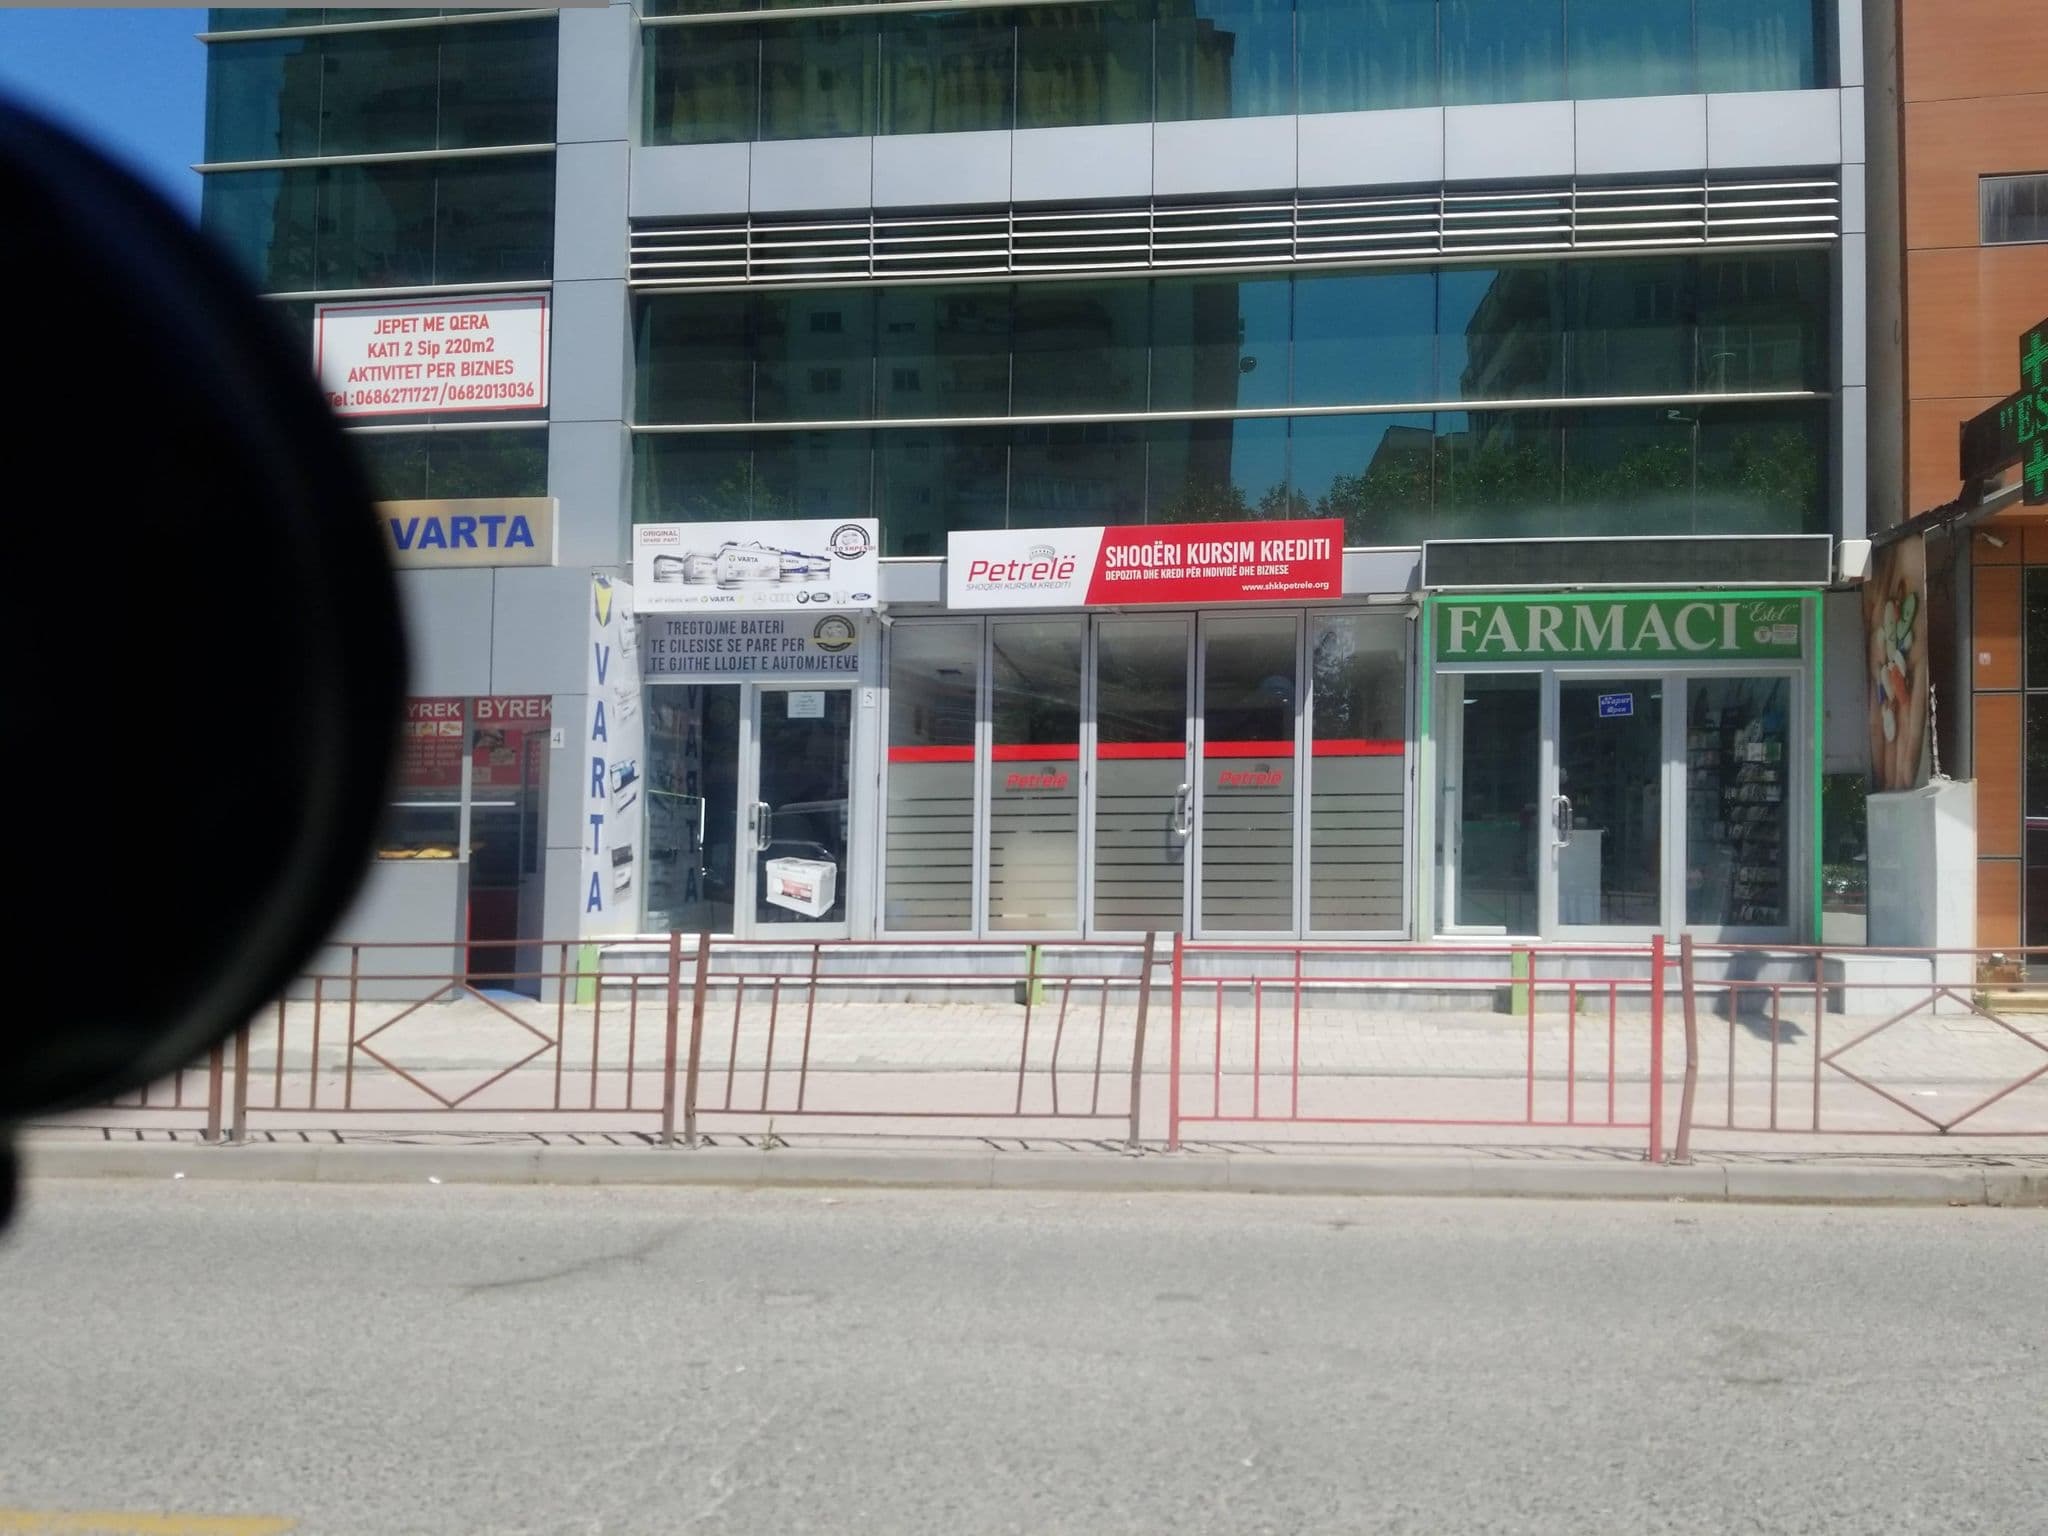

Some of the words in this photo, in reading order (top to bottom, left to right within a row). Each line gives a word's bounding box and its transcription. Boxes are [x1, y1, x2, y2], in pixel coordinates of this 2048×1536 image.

[374, 318, 419, 334] JEPET
[423, 316, 445, 332] ME
[449, 314, 489, 331] QERA
[368, 341, 400, 358] KATI
[404, 341, 413, 356] 2
[417, 340, 440, 359] Sip
[445, 337, 495, 354] 220m2
[348, 364, 423, 382] AKTIVITET
[427, 362, 455, 378] PER
[461, 359, 514, 376] BIZNES
[390, 515, 534, 549] VARTA
[1106, 540, 1181, 568] SHOQËRI
[1187, 541, 1254, 565] KURSIM
[1261, 538, 1330, 562] KREDITI
[968, 555, 1076, 582] Petrelë
[1106, 569, 1142, 581] DEPOZITA
[1143, 569, 1160, 580] DHE
[1161, 568, 1184, 579] KREDI
[1186, 566, 1201, 578] PËR
[1203, 565, 1237, 577] INDIVIDË
[1240, 566, 1255, 576] DHE
[1257, 564, 1289, 576] BIZNESE
[1242, 581, 1329, 591] www.shkkpetrele.org
[710, 595, 735, 603] VARTA
[667, 621, 737, 635] TREGTOJME
[741, 620, 784, 634] BATERI
[1446, 603, 1740, 653] FARMACI
[651, 640, 665, 653] TE
[670, 639, 723, 653] CILESISE
[727, 639, 742, 652] SE
[746, 638, 777, 652] PARE
[782, 638, 805, 652] PER
[650, 657, 665, 671] TE
[669, 657, 710, 671] GJITHE
[715, 656, 757, 670] LLOJET
[762, 656, 768, 670] E
[772, 655, 858, 670] AUTOMJETEVE
[407, 703, 461, 717] YREK
[478, 701, 552, 718] BYREK
[553, 732, 561, 744] 4
[586, 642, 610, 913] VARTA
